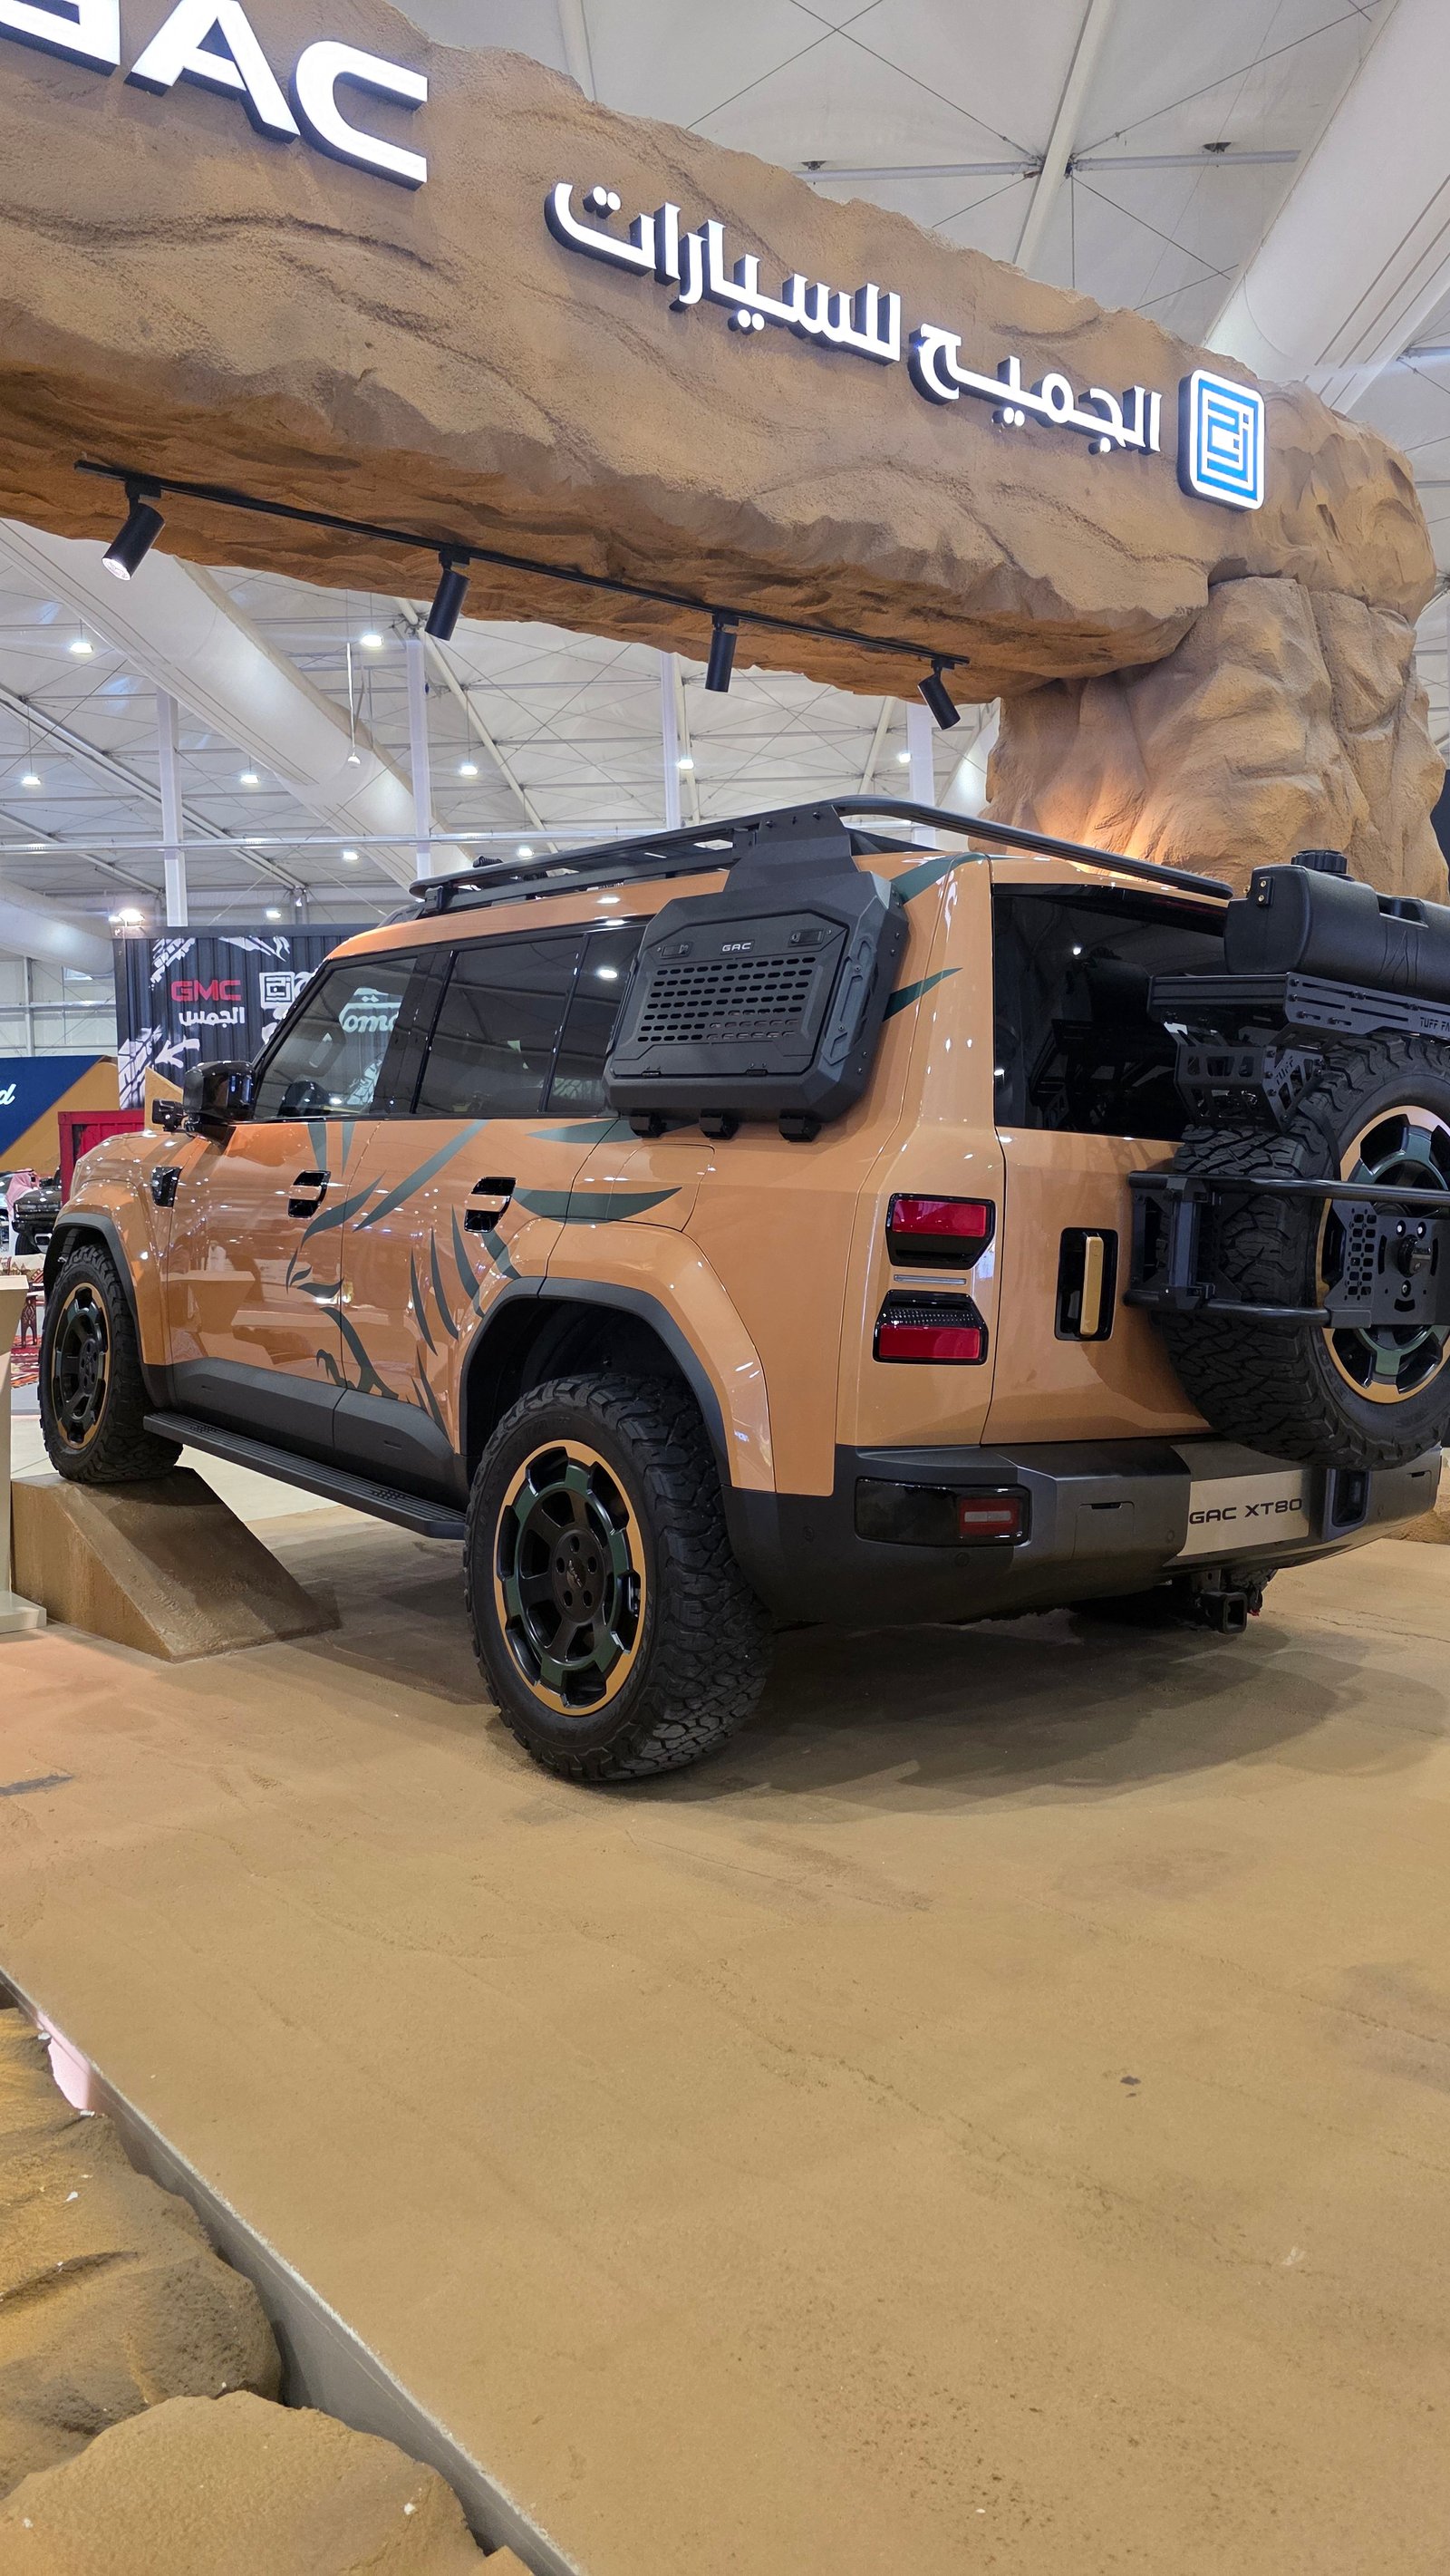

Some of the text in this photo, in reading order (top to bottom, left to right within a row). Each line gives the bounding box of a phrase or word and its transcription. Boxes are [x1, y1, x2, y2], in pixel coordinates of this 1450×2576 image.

[549, 181, 902, 363] للسيارات
[915, 323, 1163, 454] الجميح
[721, 942, 752, 952] GAC
[170, 979, 242, 1002] GMC
[178, 1006, 246, 1029] الجمس
[1419, 1016, 1439, 1030] TUFF
[1188, 1497, 1303, 1525] GAC XT80
